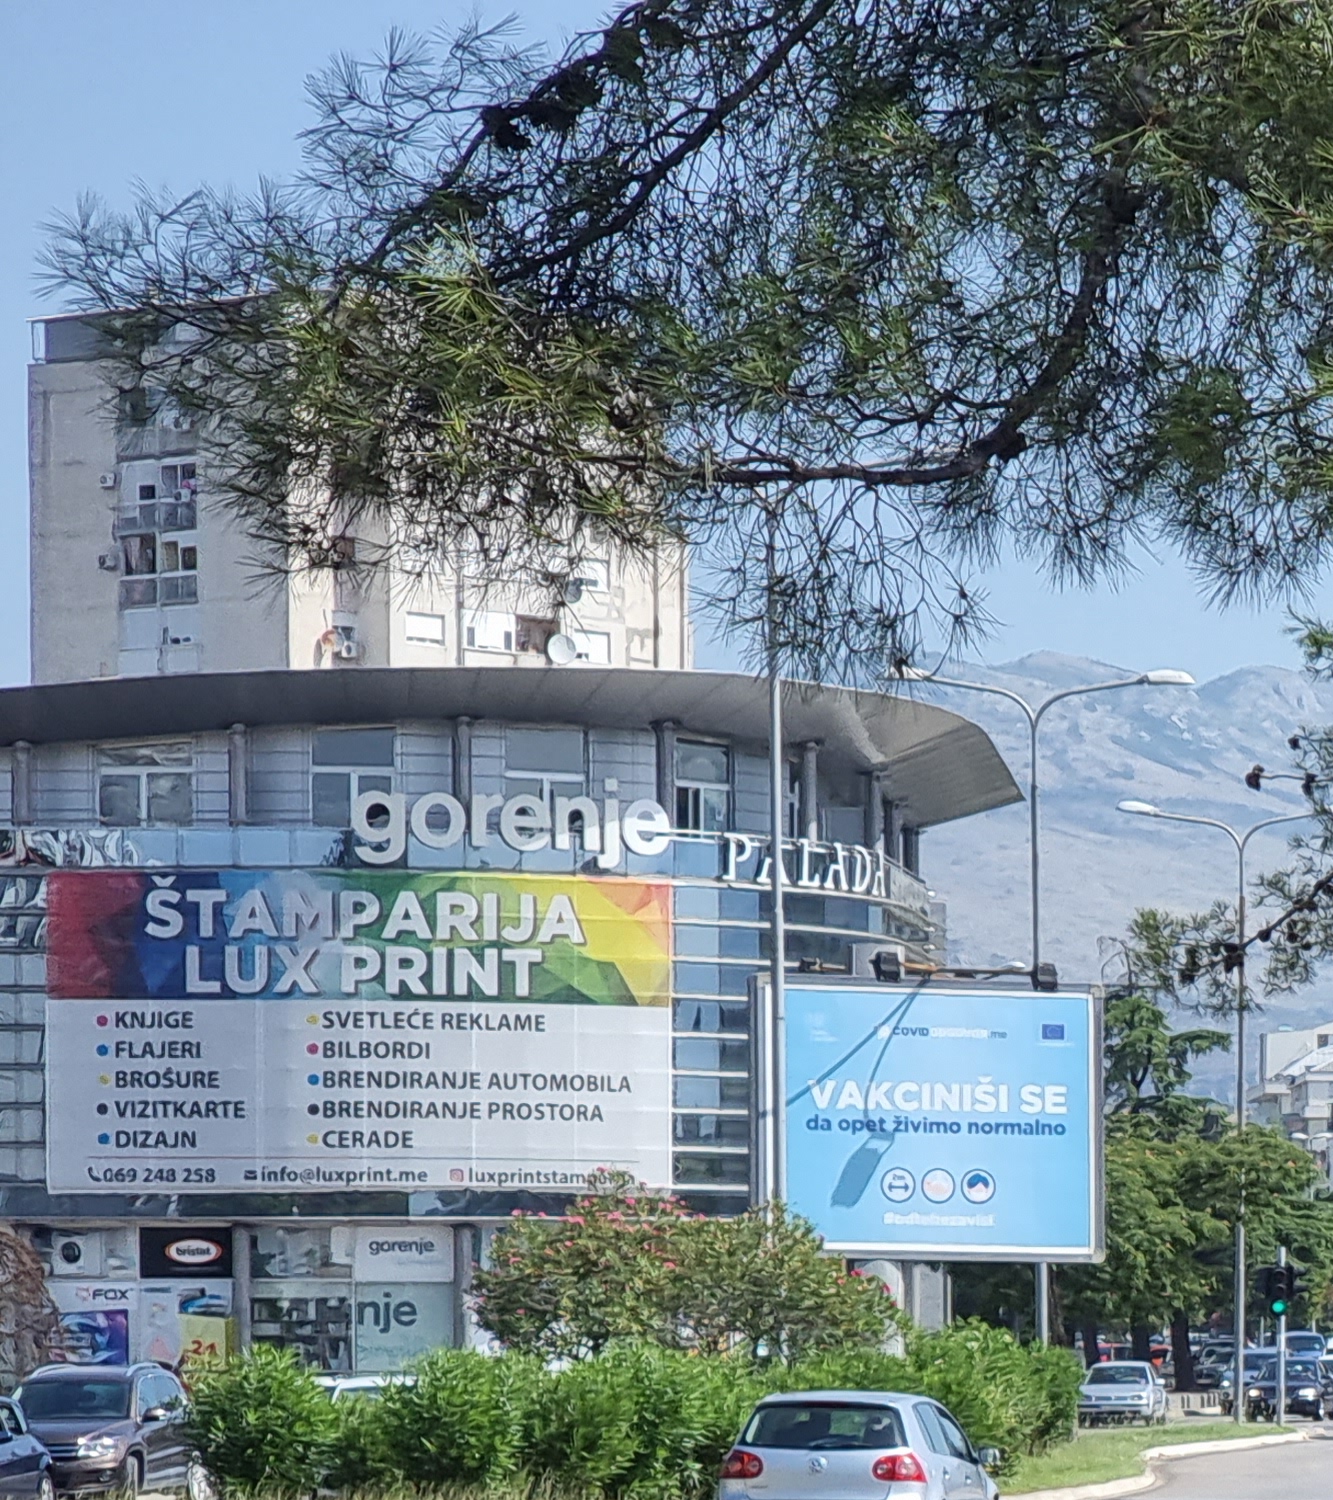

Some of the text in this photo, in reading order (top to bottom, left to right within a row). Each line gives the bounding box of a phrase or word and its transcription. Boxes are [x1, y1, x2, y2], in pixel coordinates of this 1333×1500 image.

[352, 776, 671, 869] gorenje
[143, 875, 586, 945] ŠTAMPARIJA
[185, 944, 544, 998] LUX PRINT
[114, 1010, 194, 1029] KNJIGE
[321, 1008, 546, 1033] SVETLEĆE REKLAME
[114, 1040, 202, 1059] FLAJERI
[322, 1041, 431, 1060] BILBORDI
[114, 1067, 220, 1089] BROŠURE
[322, 1070, 633, 1094] BRENDIRANJE AUTOMOBILA
[807, 1075, 1068, 1115] VAKCINIŠI SE
[114, 1100, 247, 1119] VIZITKARTE
[322, 1100, 604, 1123] BRENDIRANJE PROSTORA
[805, 1114, 1067, 1136] da opet živimo normalno
[115, 1130, 198, 1149] DIZAJN
[322, 1130, 414, 1149] CERADE
[103, 1167, 137, 1183] 069
[142, 1167, 177, 1183] 248
[261, 1165, 428, 1185] info@luxprint.me
[469, 1166, 636, 1187] luxprintstampa
[368, 1237, 435, 1256] gorenje
[92, 1287, 130, 1301] FOX
